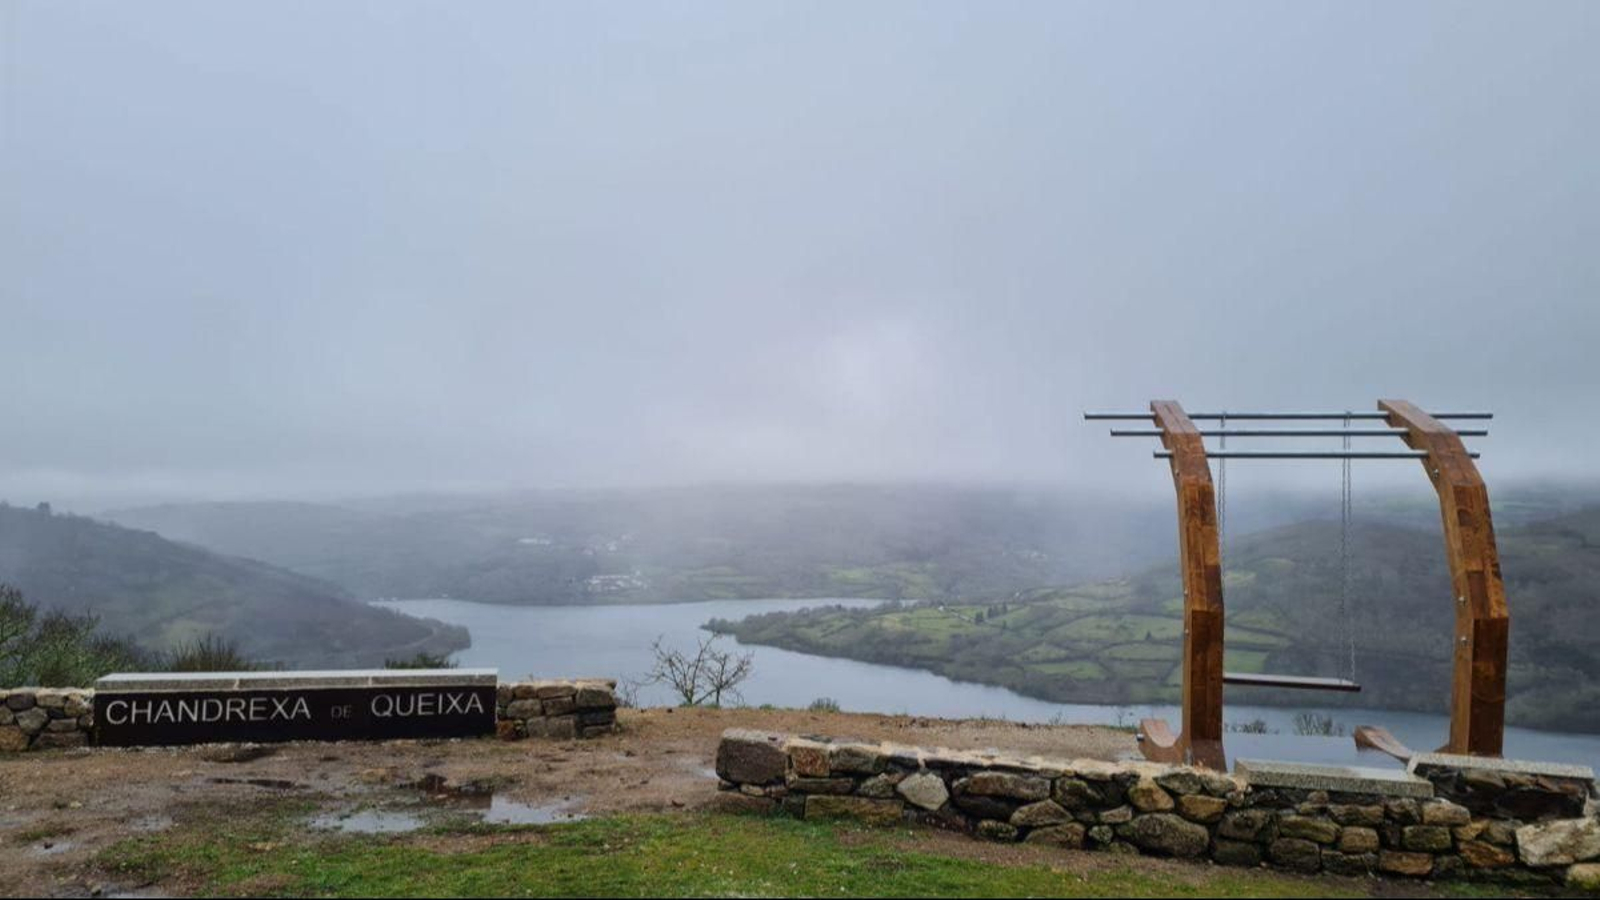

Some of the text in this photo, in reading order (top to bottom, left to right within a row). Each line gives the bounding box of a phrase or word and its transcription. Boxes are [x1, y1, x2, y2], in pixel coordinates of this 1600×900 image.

[105, 692, 485, 725] CHANDREXA DE QUEIXA
